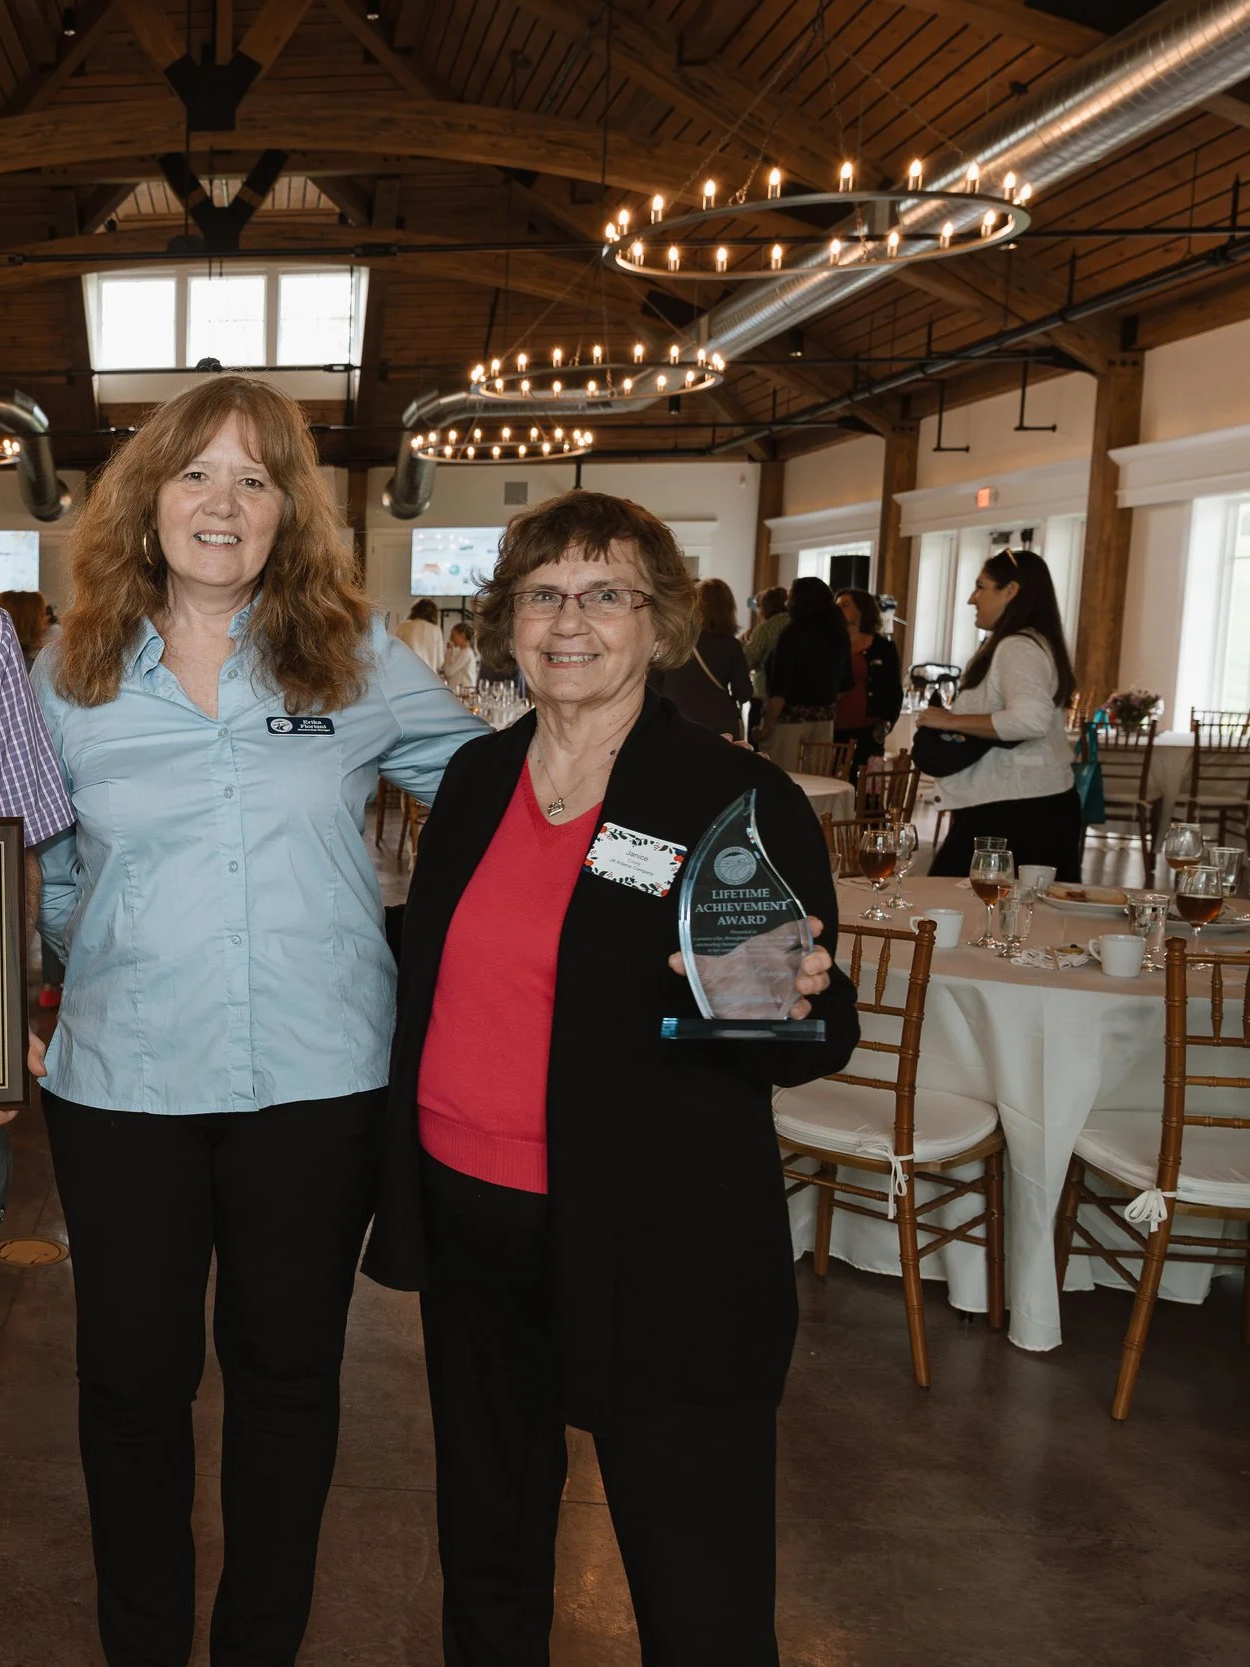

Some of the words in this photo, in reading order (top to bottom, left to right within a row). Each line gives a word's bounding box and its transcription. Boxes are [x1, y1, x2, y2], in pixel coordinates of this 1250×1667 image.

[626, 851, 648, 861] Janice
[633, 866, 653, 876] Company
[712, 888, 770, 899] LIFETIME
[695, 900, 788, 912] ACHIEVEMENT
[717, 915, 767, 925] AWARD
